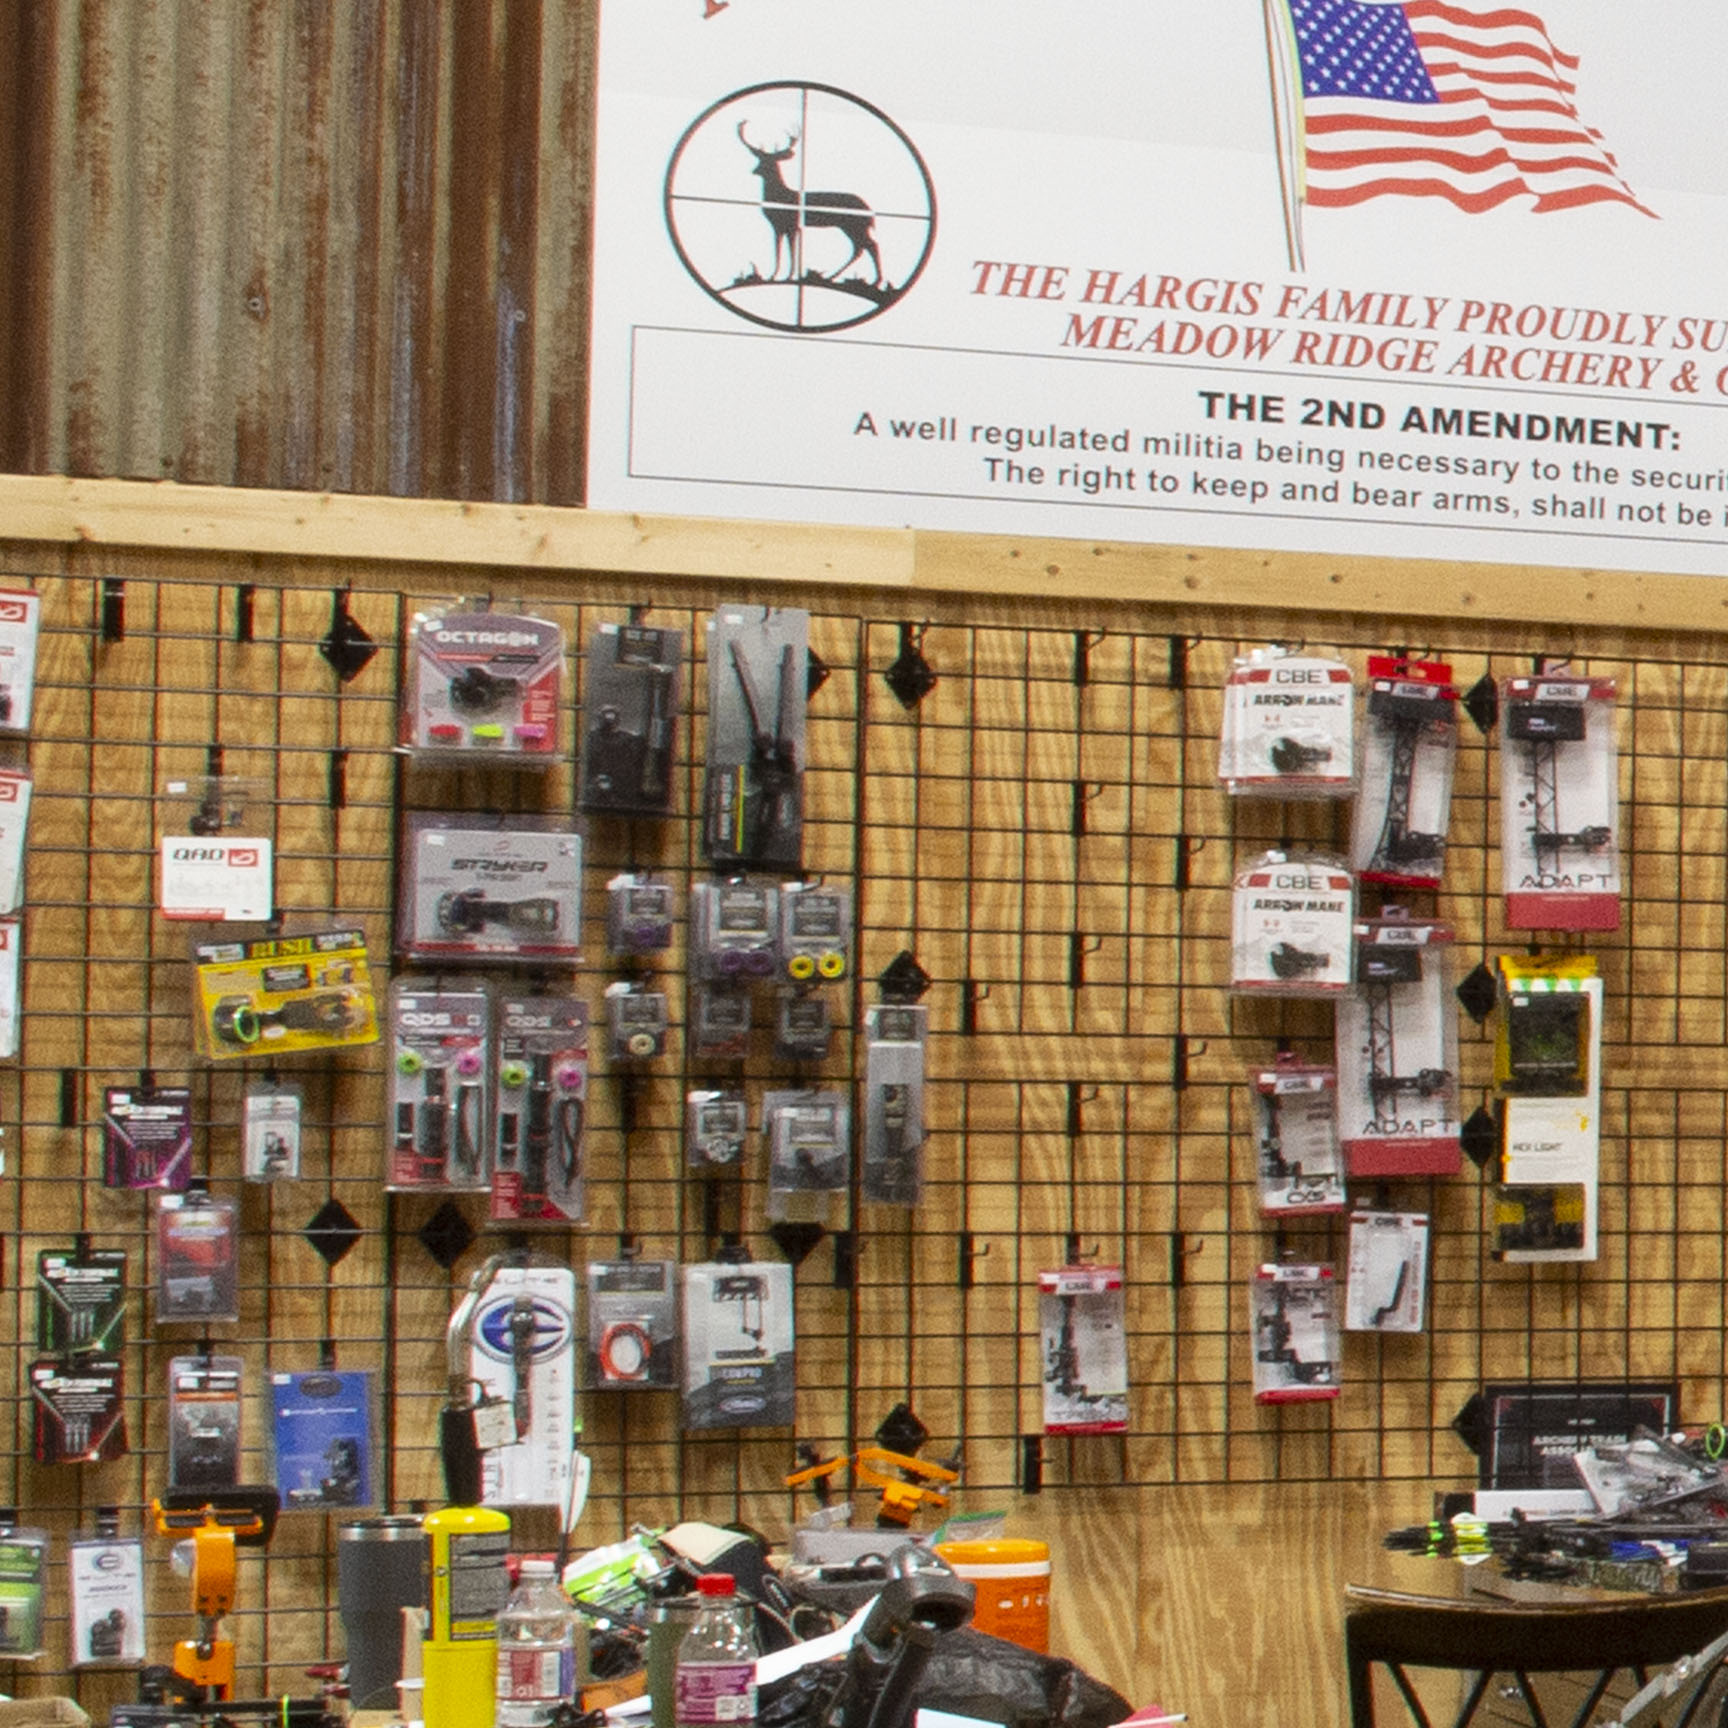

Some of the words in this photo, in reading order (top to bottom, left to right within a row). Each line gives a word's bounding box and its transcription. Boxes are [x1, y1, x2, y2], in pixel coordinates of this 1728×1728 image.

[971, 260, 1069, 301] THE
[1079, 269, 1264, 317] HARGIS
[1276, 284, 1451, 331] FAMILY
[1455, 299, 1670, 348] PROUDLY
[1060, 313, 1283, 362] MEADOW
[1292, 330, 1439, 376] RIDGE
[1448, 344, 1665, 390] ARCHERY
[1670, 360, 1699, 393] &
[1198, 391, 1285, 424] THE
[1301, 398, 1386, 430] 2ND
[1400, 405, 1681, 450] AMENDMENT:
[853, 411, 878, 436] A
[890, 417, 957, 441] well
[970, 424, 1130, 452] regulated
[1144, 433, 1243, 461] militia
[1256, 438, 1345, 473] being
[1357, 449, 1520, 484] necessary
[1532, 458, 1560, 482] to
[1572, 460, 1620, 486] the
[984, 457, 1045, 484] The
[1058, 464, 1135, 494] right
[1149, 468, 1180, 493] to
[1192, 471, 1270, 504] keep
[1281, 479, 1339, 504] and
[1352, 482, 1422, 509] bear
[1433, 491, 1520, 519] arms,
[1532, 493, 1605, 520] shall
[1617, 501, 1667, 525] not
[1677, 503, 1712, 527] be
[1275, 669, 1322, 684] CBE
[452, 858, 548, 872] STRYKER
[1276, 875, 1322, 890] CBE
[1519, 874, 1612, 889] ADAPT
[1362, 1118, 1454, 1134] ADAPT
